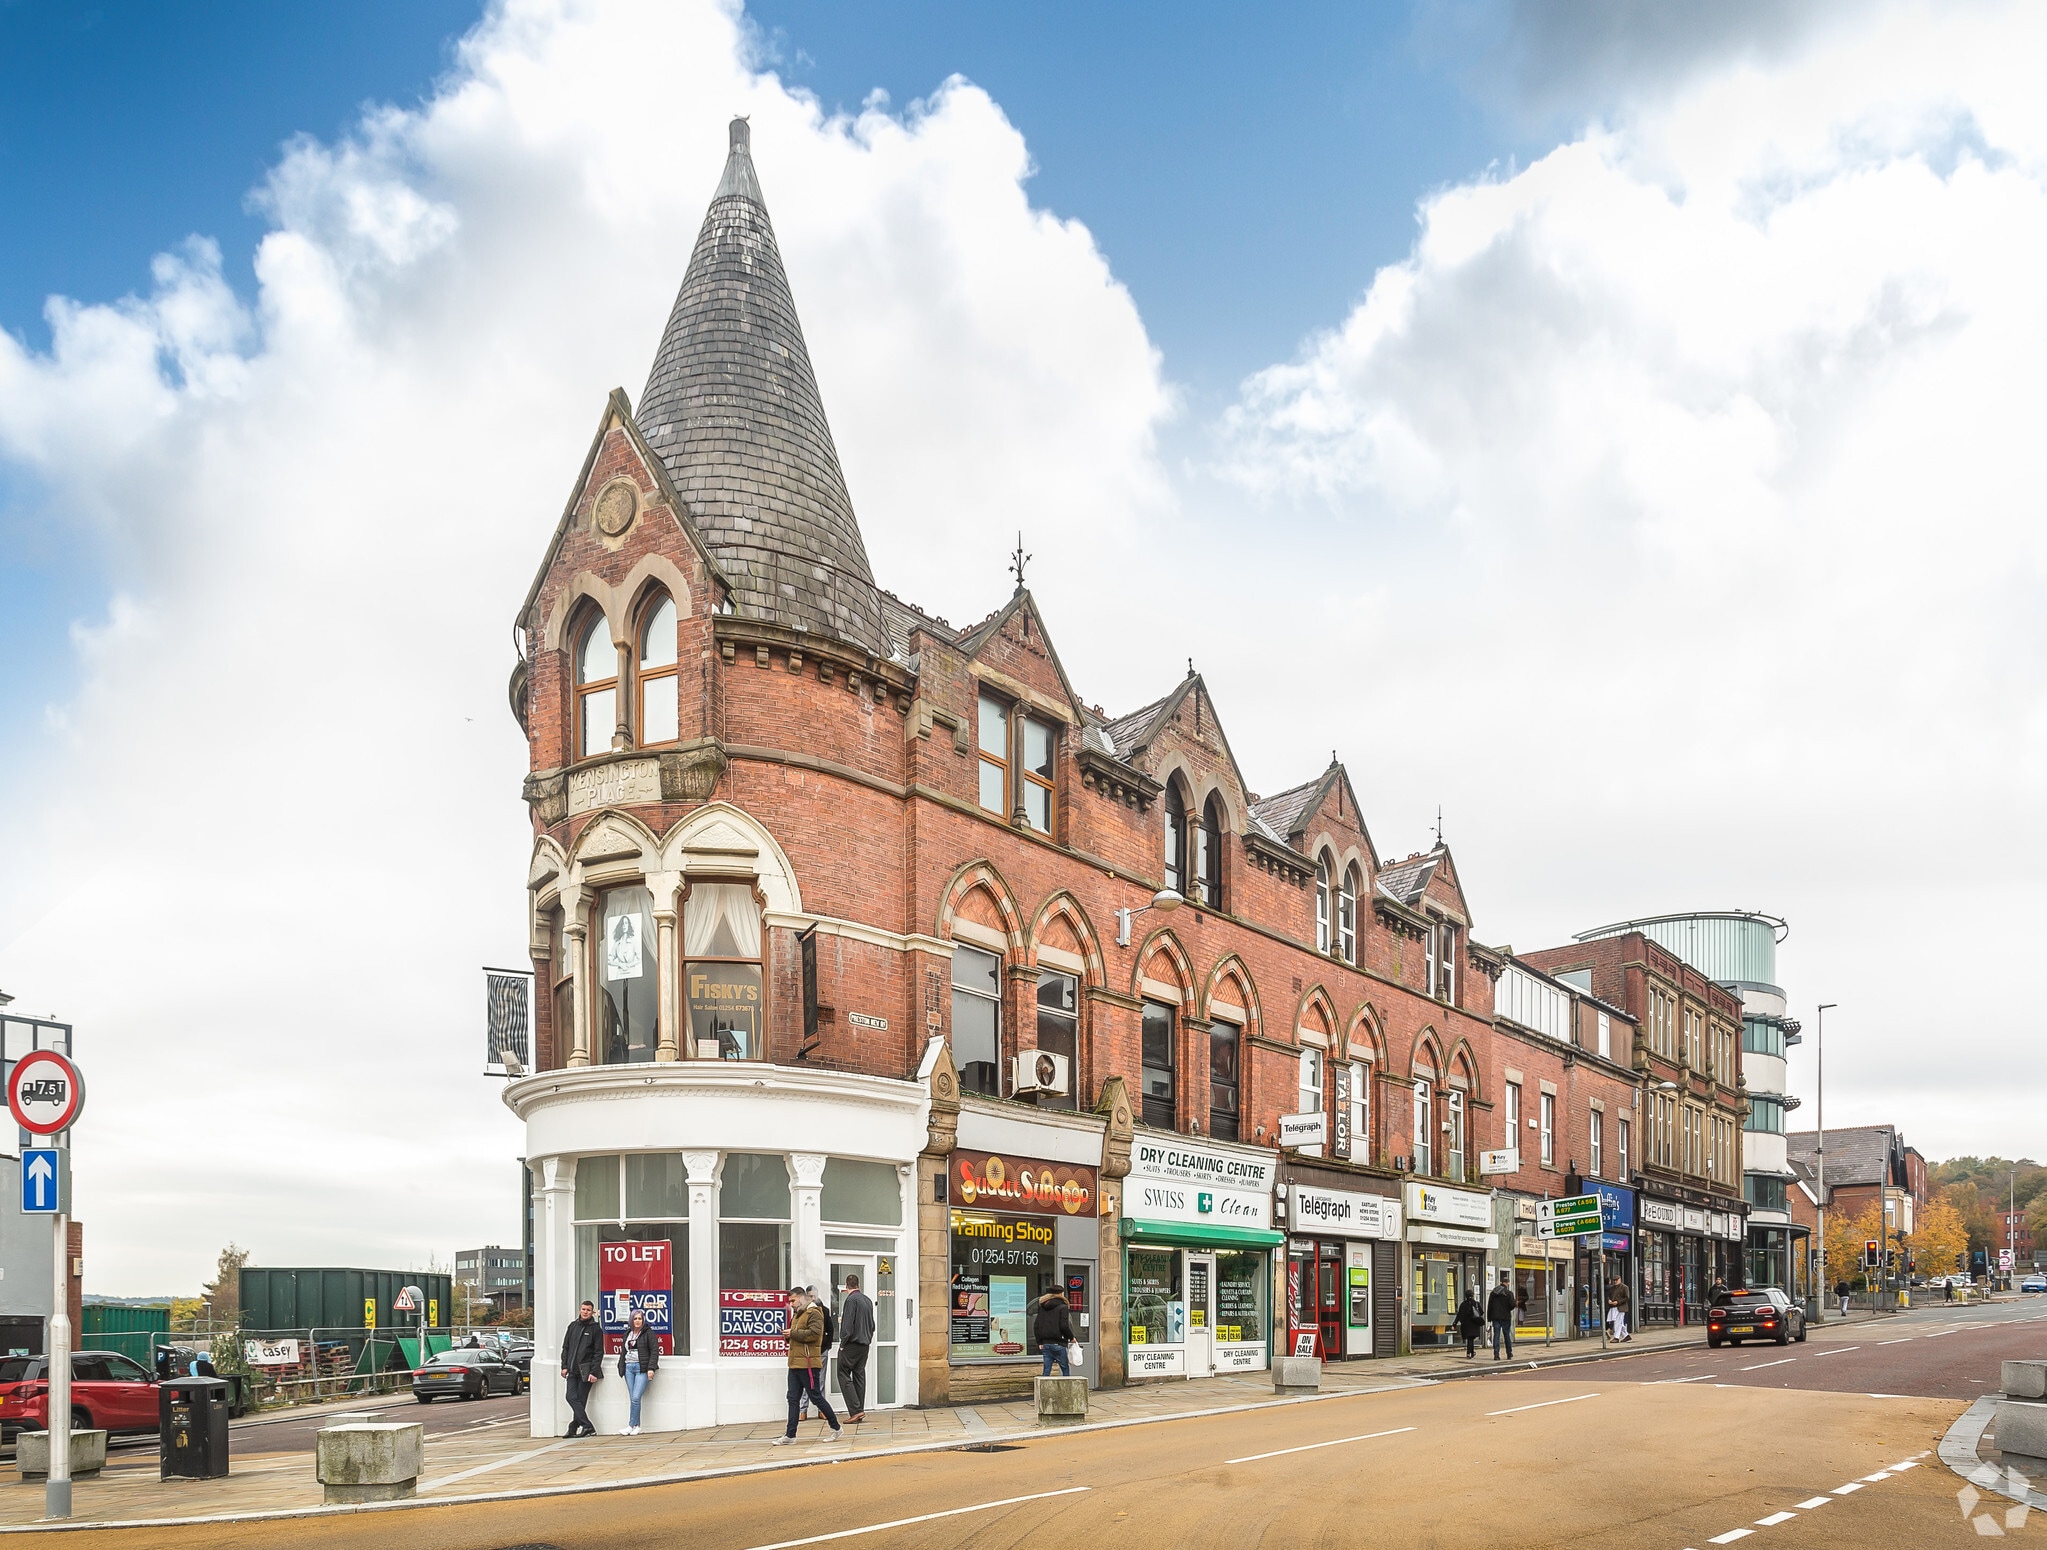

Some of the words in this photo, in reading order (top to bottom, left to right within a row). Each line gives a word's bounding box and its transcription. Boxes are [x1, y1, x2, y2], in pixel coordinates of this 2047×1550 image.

[569, 759, 660, 793] KENSINGTON
[691, 974, 758, 1001] FISKY'S
[850, 1014, 870, 1025] PRESTON
[1337, 1077, 1347, 1151] TAYLOR
[1284, 1121, 1321, 1134] Telegraph
[1140, 1147, 1166, 1164] DRY
[1167, 1152, 1224, 1173] CLEANING
[1227, 1161, 1266, 1180] CENTRE
[1144, 1187, 1185, 1210] SWISS
[1220, 1197, 1259, 1217] Clean
[1427, 1194, 1436, 1204] Key
[1299, 1194, 1351, 1222] Telegraph
[955, 1216, 1014, 1243] Tanning
[1016, 1221, 1053, 1246] Shop
[604, 1247, 627, 1262] TO
[631, 1245, 665, 1262] LET
[971, 1248, 1005, 1265] 01254
[1007, 1250, 1039, 1266] 57156
[961, 1283, 972, 1291] Light
[972, 1283, 988, 1291] Therapy
[721, 1292, 750, 1301] TO
[722, 1310, 784, 1322] TREVOR
[722, 1322, 784, 1334] DAWSON
[1301, 1335, 1312, 1344] ON
[262, 1345, 291, 1359] casey
[1234, 1349, 1259, 1357] CLEANING
[1296, 1344, 1313, 1354] SALE
[1133, 1353, 1145, 1361] DRY
[1146, 1353, 1175, 1361] CLEANING
[1232, 1357, 1252, 1366] CENTRE
[1144, 1361, 1166, 1370] CENTRE
